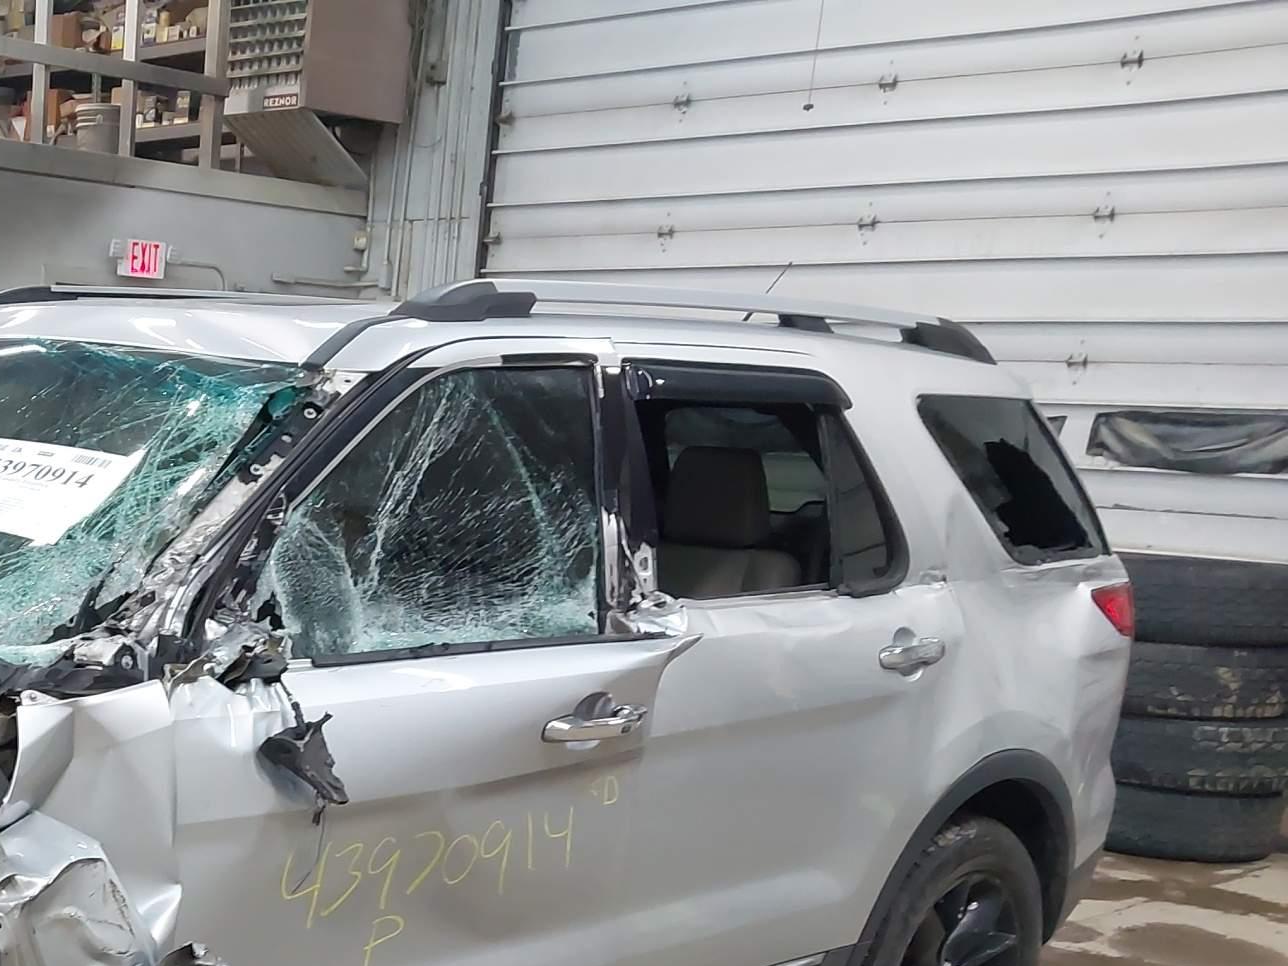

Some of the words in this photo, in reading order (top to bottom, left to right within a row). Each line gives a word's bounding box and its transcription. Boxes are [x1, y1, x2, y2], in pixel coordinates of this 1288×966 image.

[263, 95, 297, 107] REZNOR
[130, 241, 160, 273] EXIT
[280, 805, 575, 930] 43970914
